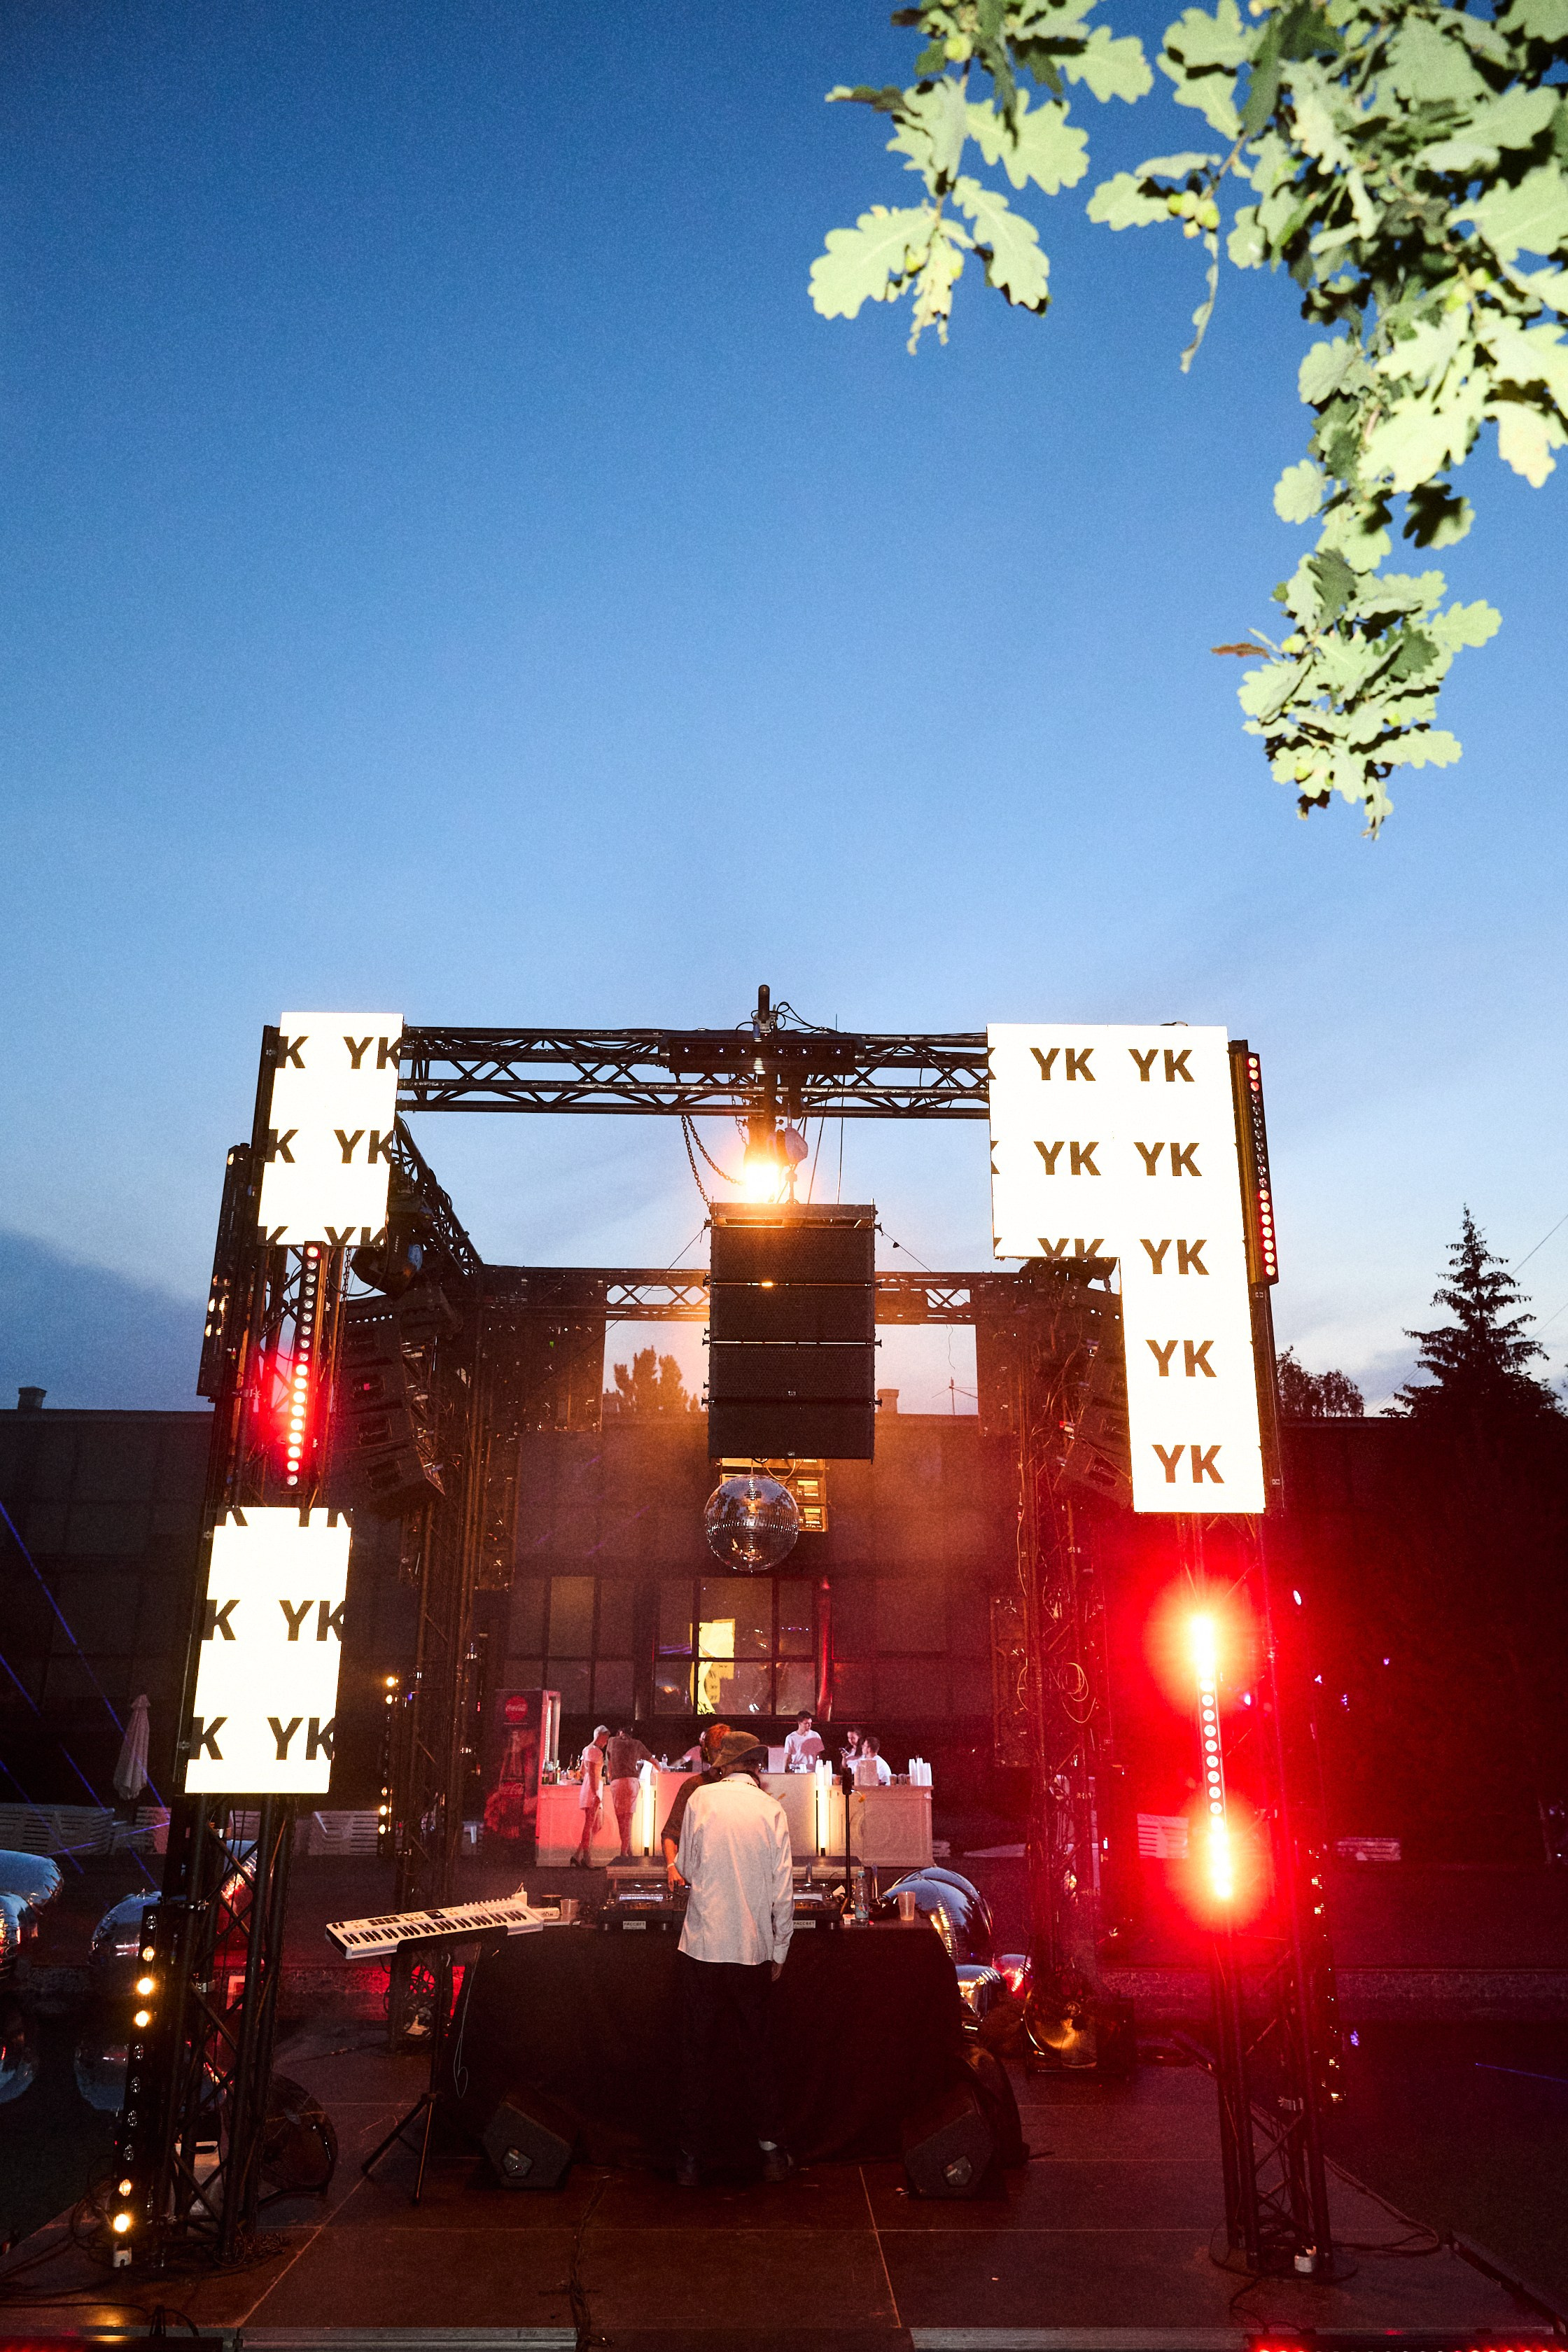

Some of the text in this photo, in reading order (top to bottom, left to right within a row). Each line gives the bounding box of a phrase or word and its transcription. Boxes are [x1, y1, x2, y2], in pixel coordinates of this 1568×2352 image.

[342, 1036, 402, 1070] YK
[1029, 1047, 1096, 1082] YK
[1128, 1049, 1196, 1082] YK
[333, 1129, 394, 1164] YK
[1033, 1140, 1102, 1176] YK
[1133, 1142, 1203, 1177] YK
[1139, 1238, 1210, 1275] YK
[1145, 1339, 1217, 1378] YK
[1151, 1444, 1225, 1484] YK
[278, 1600, 345, 1642] YK
[267, 1716, 336, 1760] YK
